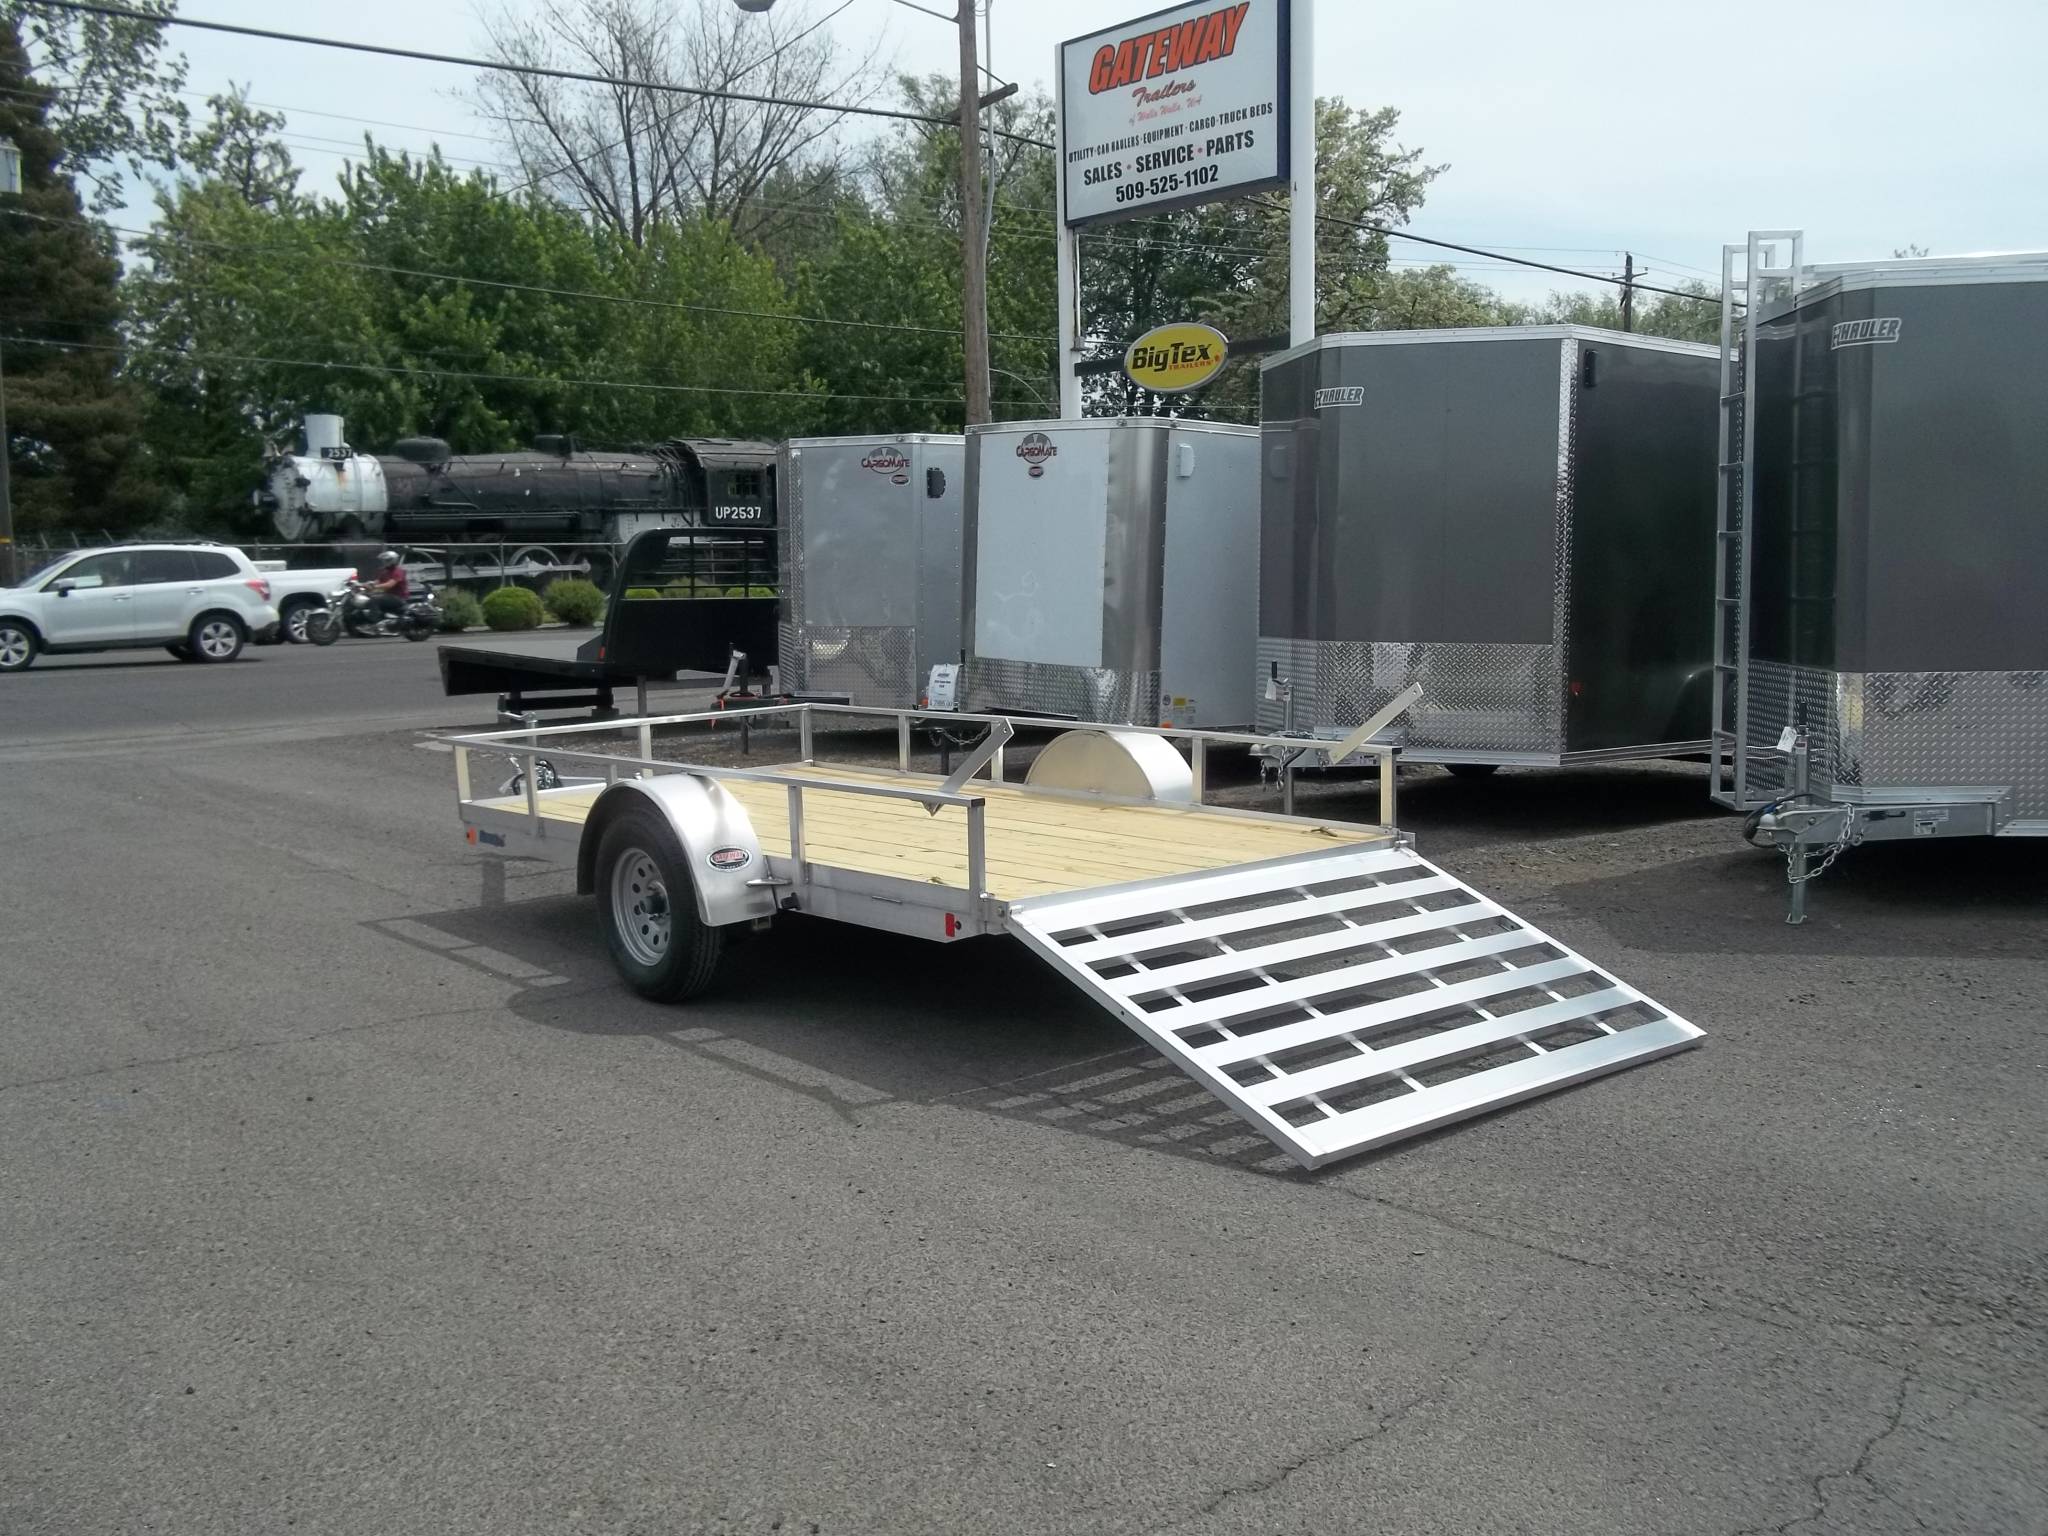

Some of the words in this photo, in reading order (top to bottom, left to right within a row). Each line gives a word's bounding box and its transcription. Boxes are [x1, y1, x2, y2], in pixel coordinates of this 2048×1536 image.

[1088, 2, 1250, 95] GATEWAY
[1069, 146, 1094, 163] UTILITY
[1111, 134, 1140, 153] HAULERS
[1143, 124, 1184, 144] EQUIPMENT
[1189, 115, 1216, 132] CARGO
[1219, 107, 1248, 125] TRUCK
[1250, 102, 1273, 118] BEDS
[1083, 161, 1123, 186] SALES
[1135, 143, 1195, 173] SERVICE
[1206, 129, 1255, 157] PARTS
[1115, 164, 1219, 203] 509-525-1102
[327, 448, 353, 459] 2537
[715, 506, 762, 519] UP2537
